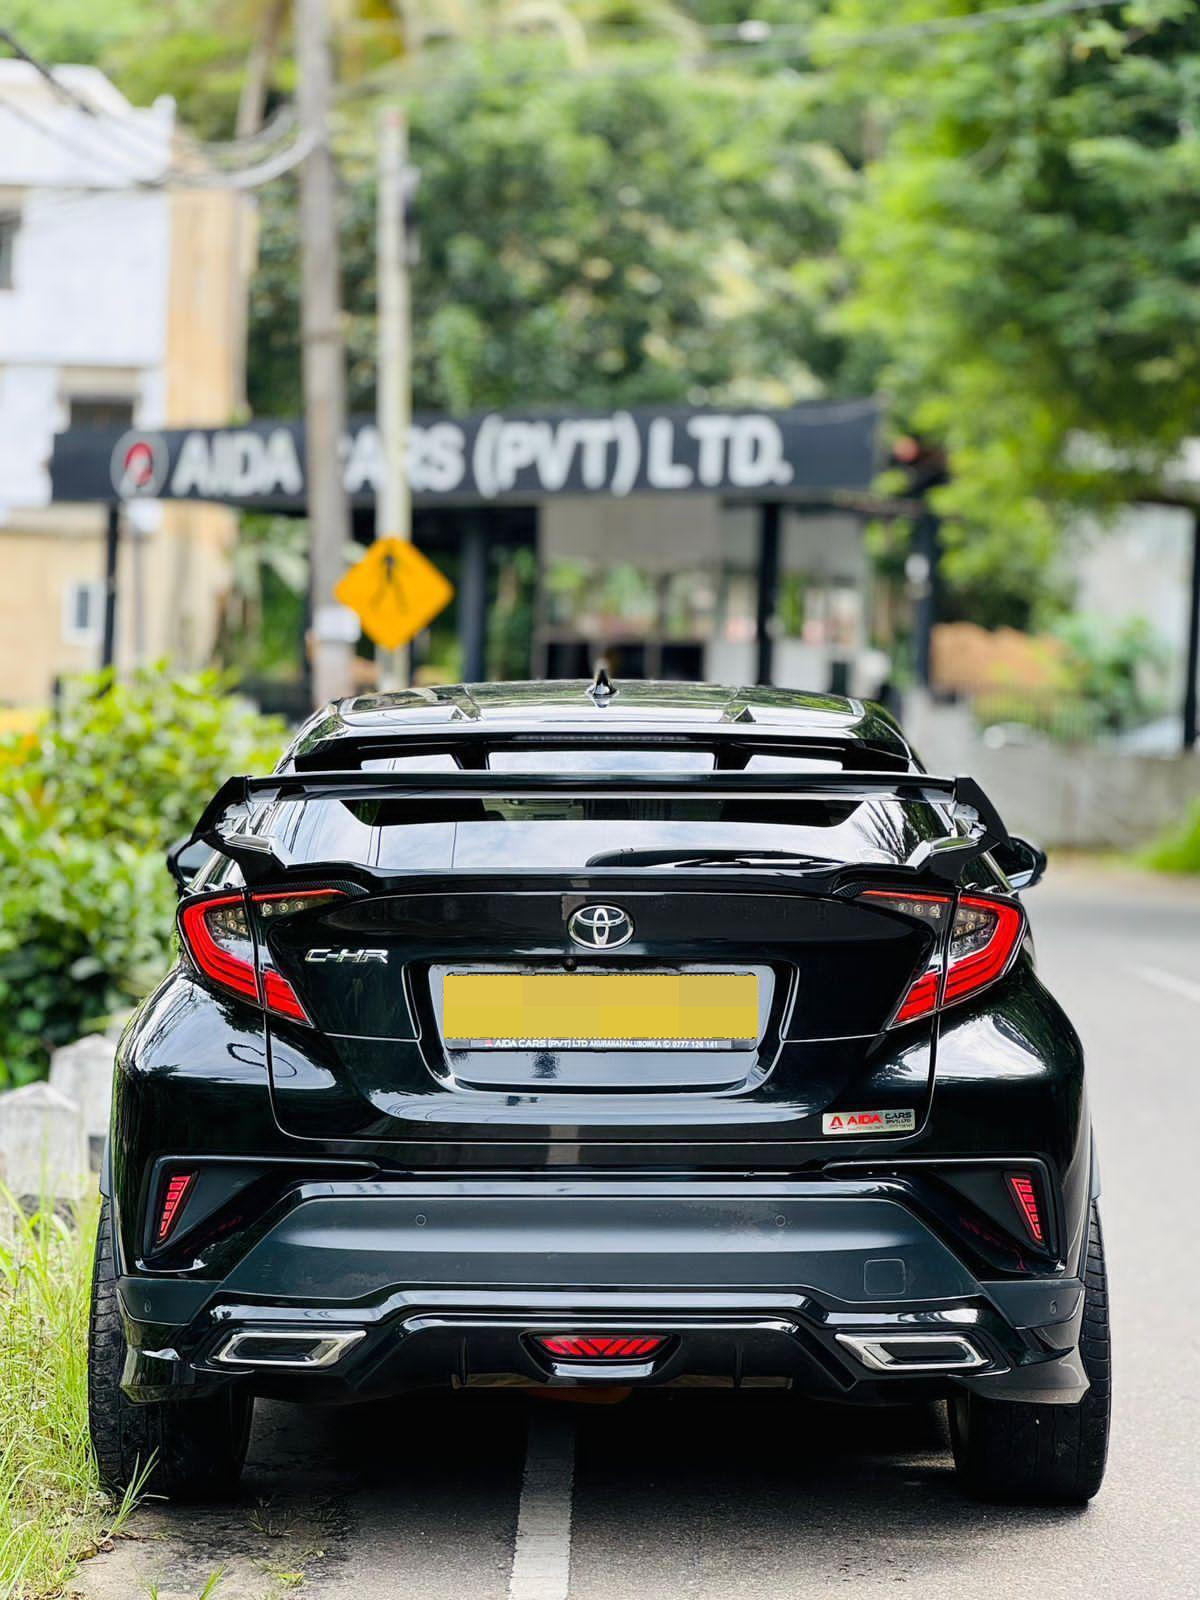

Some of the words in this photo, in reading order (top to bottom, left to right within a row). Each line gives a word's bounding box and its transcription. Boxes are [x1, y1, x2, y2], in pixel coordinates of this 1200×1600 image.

[171, 426, 303, 497] AIDA
[473, 411, 641, 498] (PVT)
[647, 414, 795, 488] LTD.
[304, 948, 389, 964] C-HR
[494, 1039, 517, 1048] AIDA
[518, 1039, 546, 1048] CARS
[572, 1039, 588, 1048] LTD
[847, 1112, 883, 1126] AIDA
[884, 1111, 912, 1120] CARS
